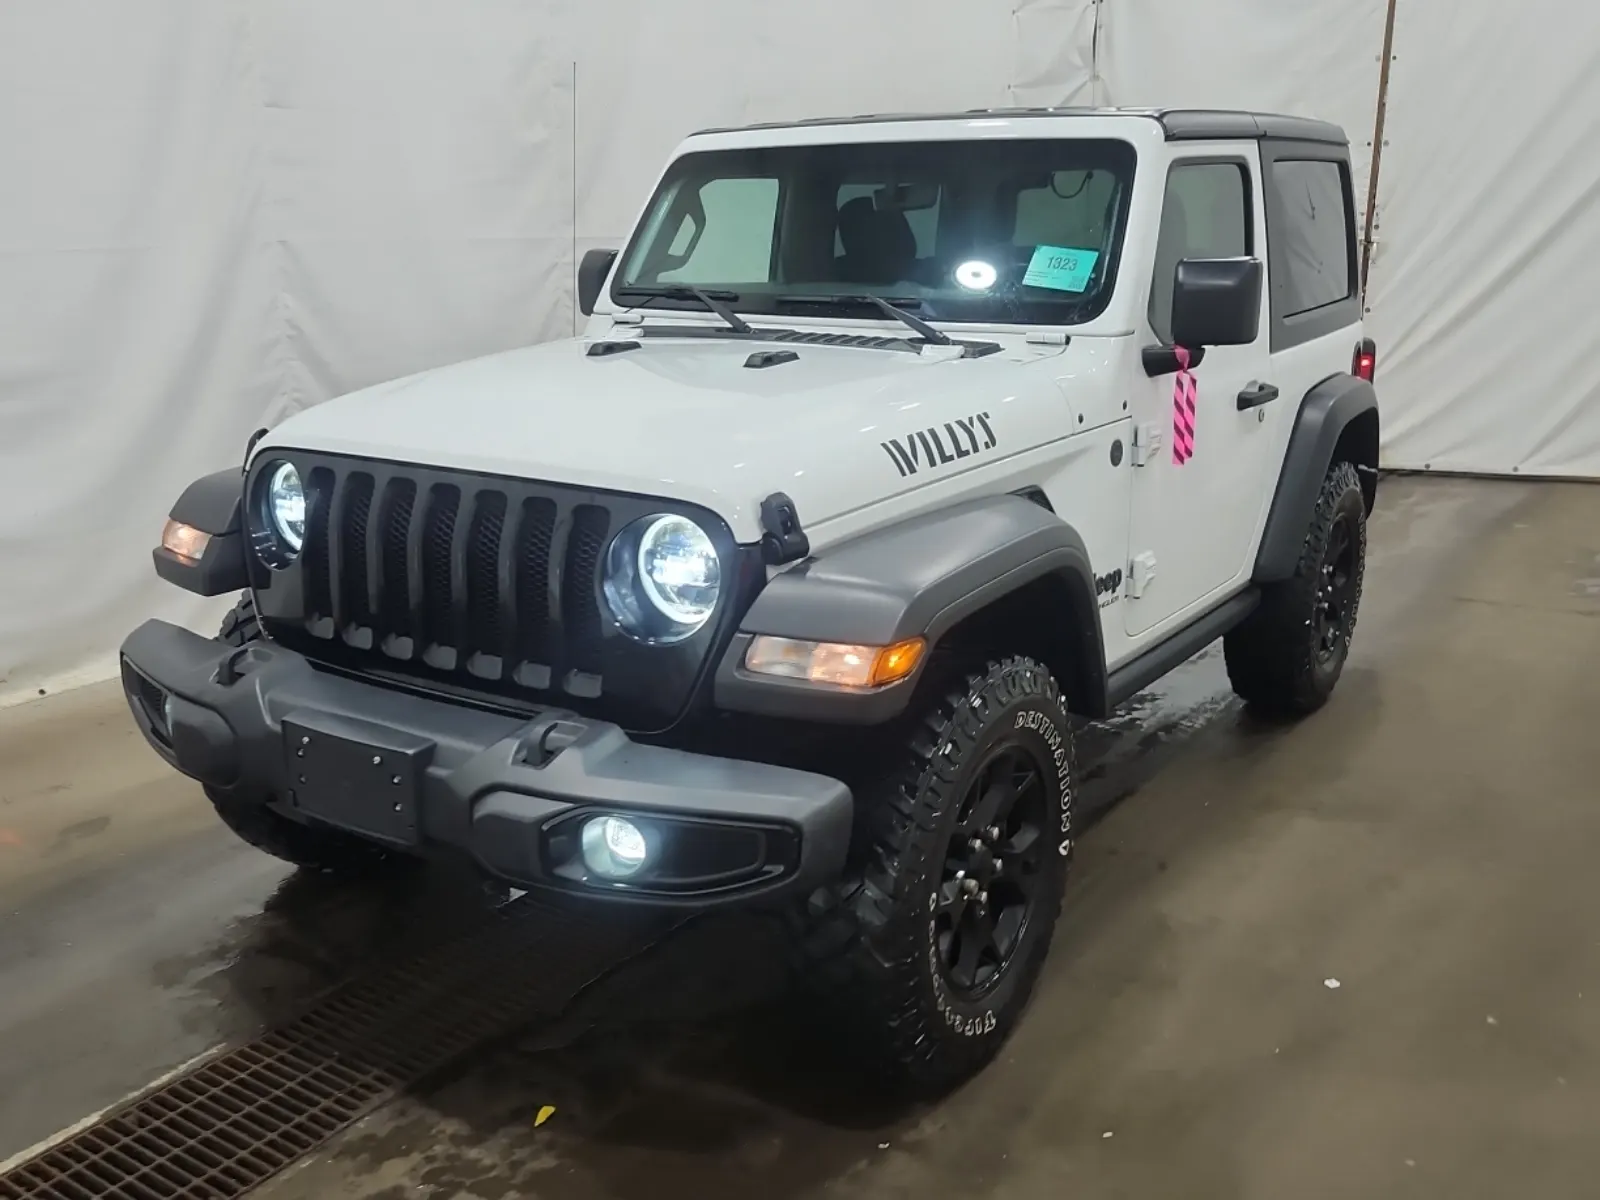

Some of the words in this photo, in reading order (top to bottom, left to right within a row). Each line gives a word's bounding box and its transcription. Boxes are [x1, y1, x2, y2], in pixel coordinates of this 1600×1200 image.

[1047, 256, 1078, 272] 1323
[880, 411, 997, 478] WILLYS
[1014, 710, 1072, 822] DESTINATION
